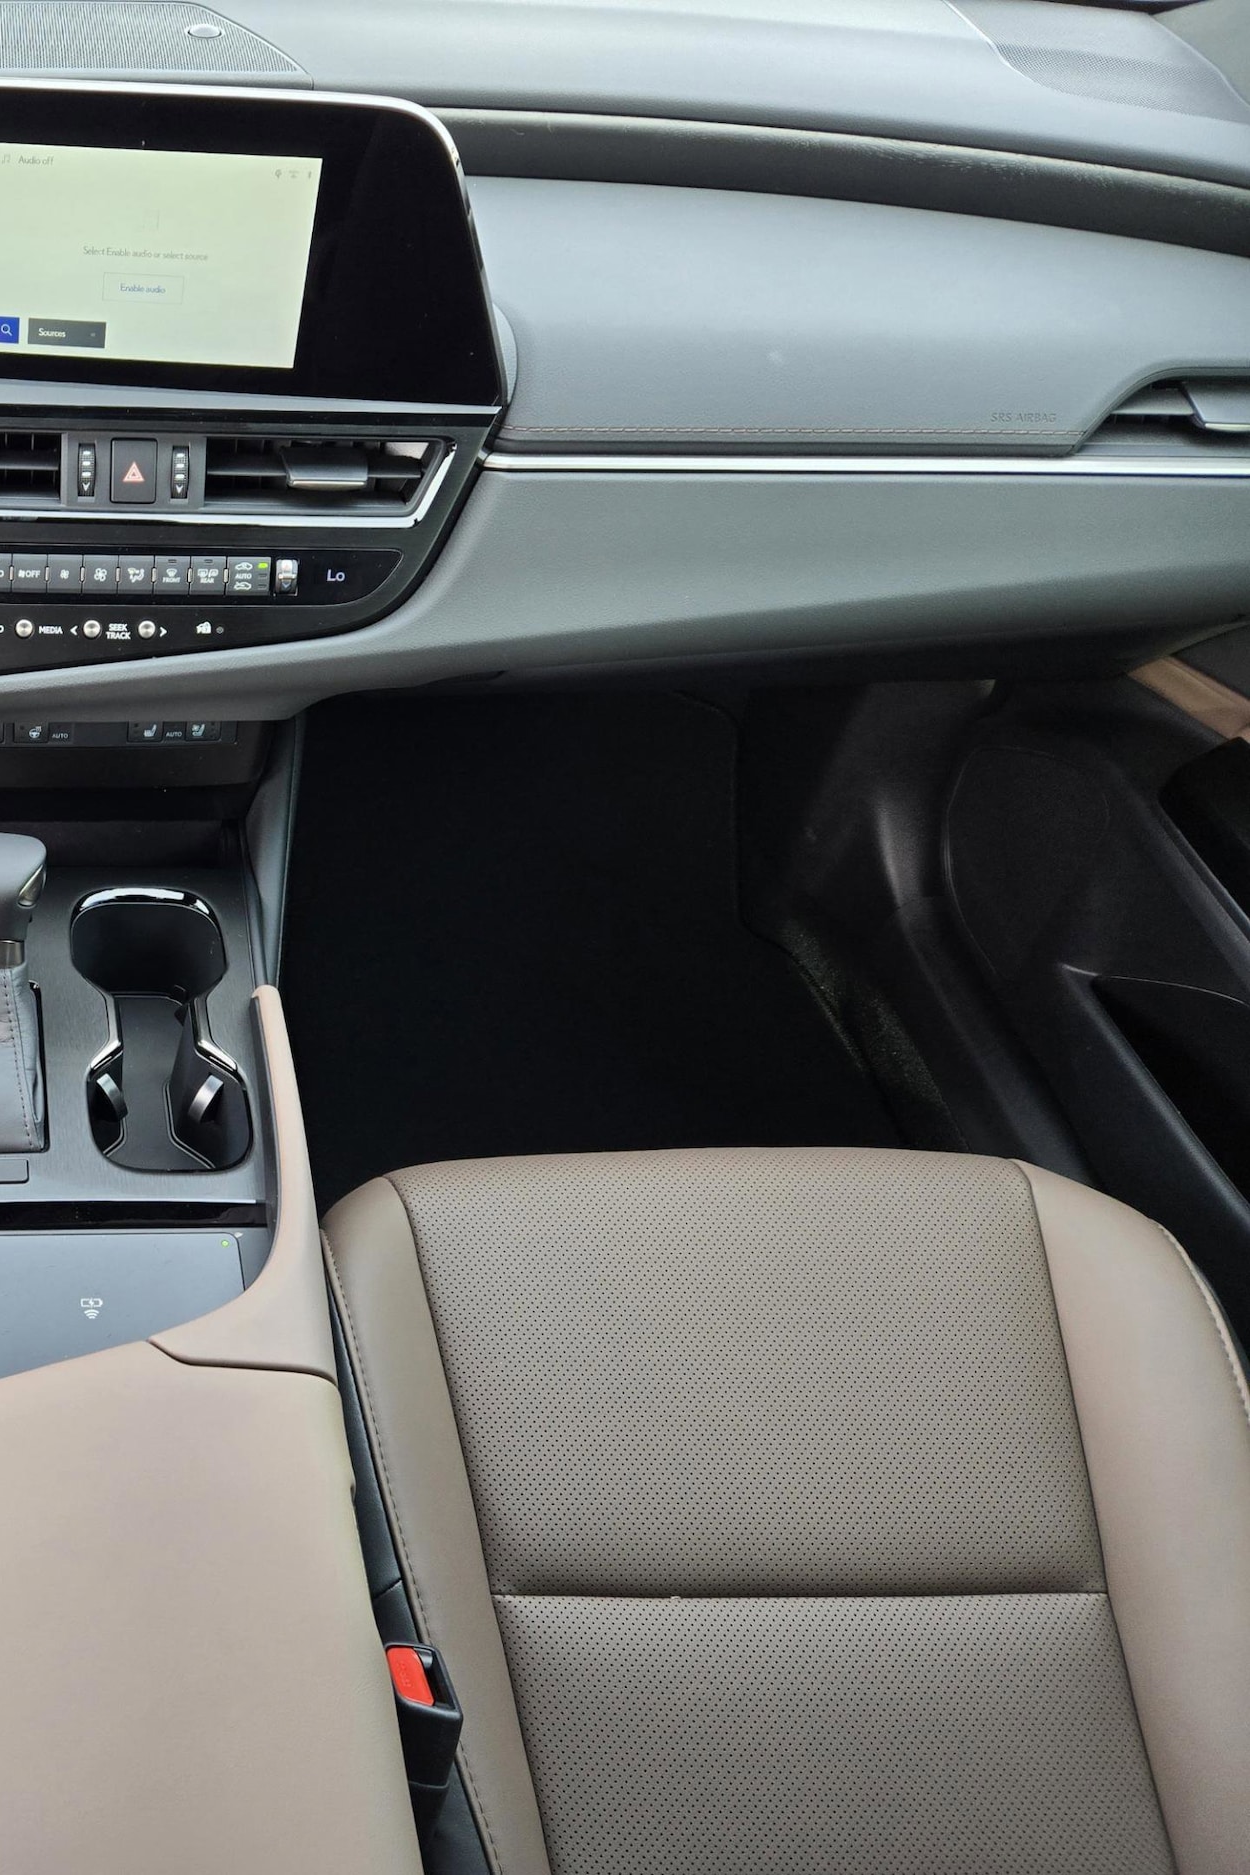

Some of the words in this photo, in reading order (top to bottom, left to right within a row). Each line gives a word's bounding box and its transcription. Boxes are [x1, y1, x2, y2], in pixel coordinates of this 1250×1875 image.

[18, 155, 41, 165] Audio
[42, 156, 55, 165] off
[83, 246, 105, 255] Select
[106, 247, 131, 257] Enable
[132, 249, 153, 258] audio
[162, 251, 184, 260] select
[120, 283, 145, 292] Enable
[145, 284, 166, 294] audio
[38, 328, 66, 338] Sources
[990, 412, 1012, 422] SRS
[1017, 412, 1057, 423] AIRBAG
[25, 570, 41, 578] OFF
[235, 572, 252, 580] AUTO
[326, 569, 346, 582] Lo
[38, 626, 64, 635] MEDIA
[108, 623, 128, 632] SEEK
[105, 632, 131, 640] TRACK
